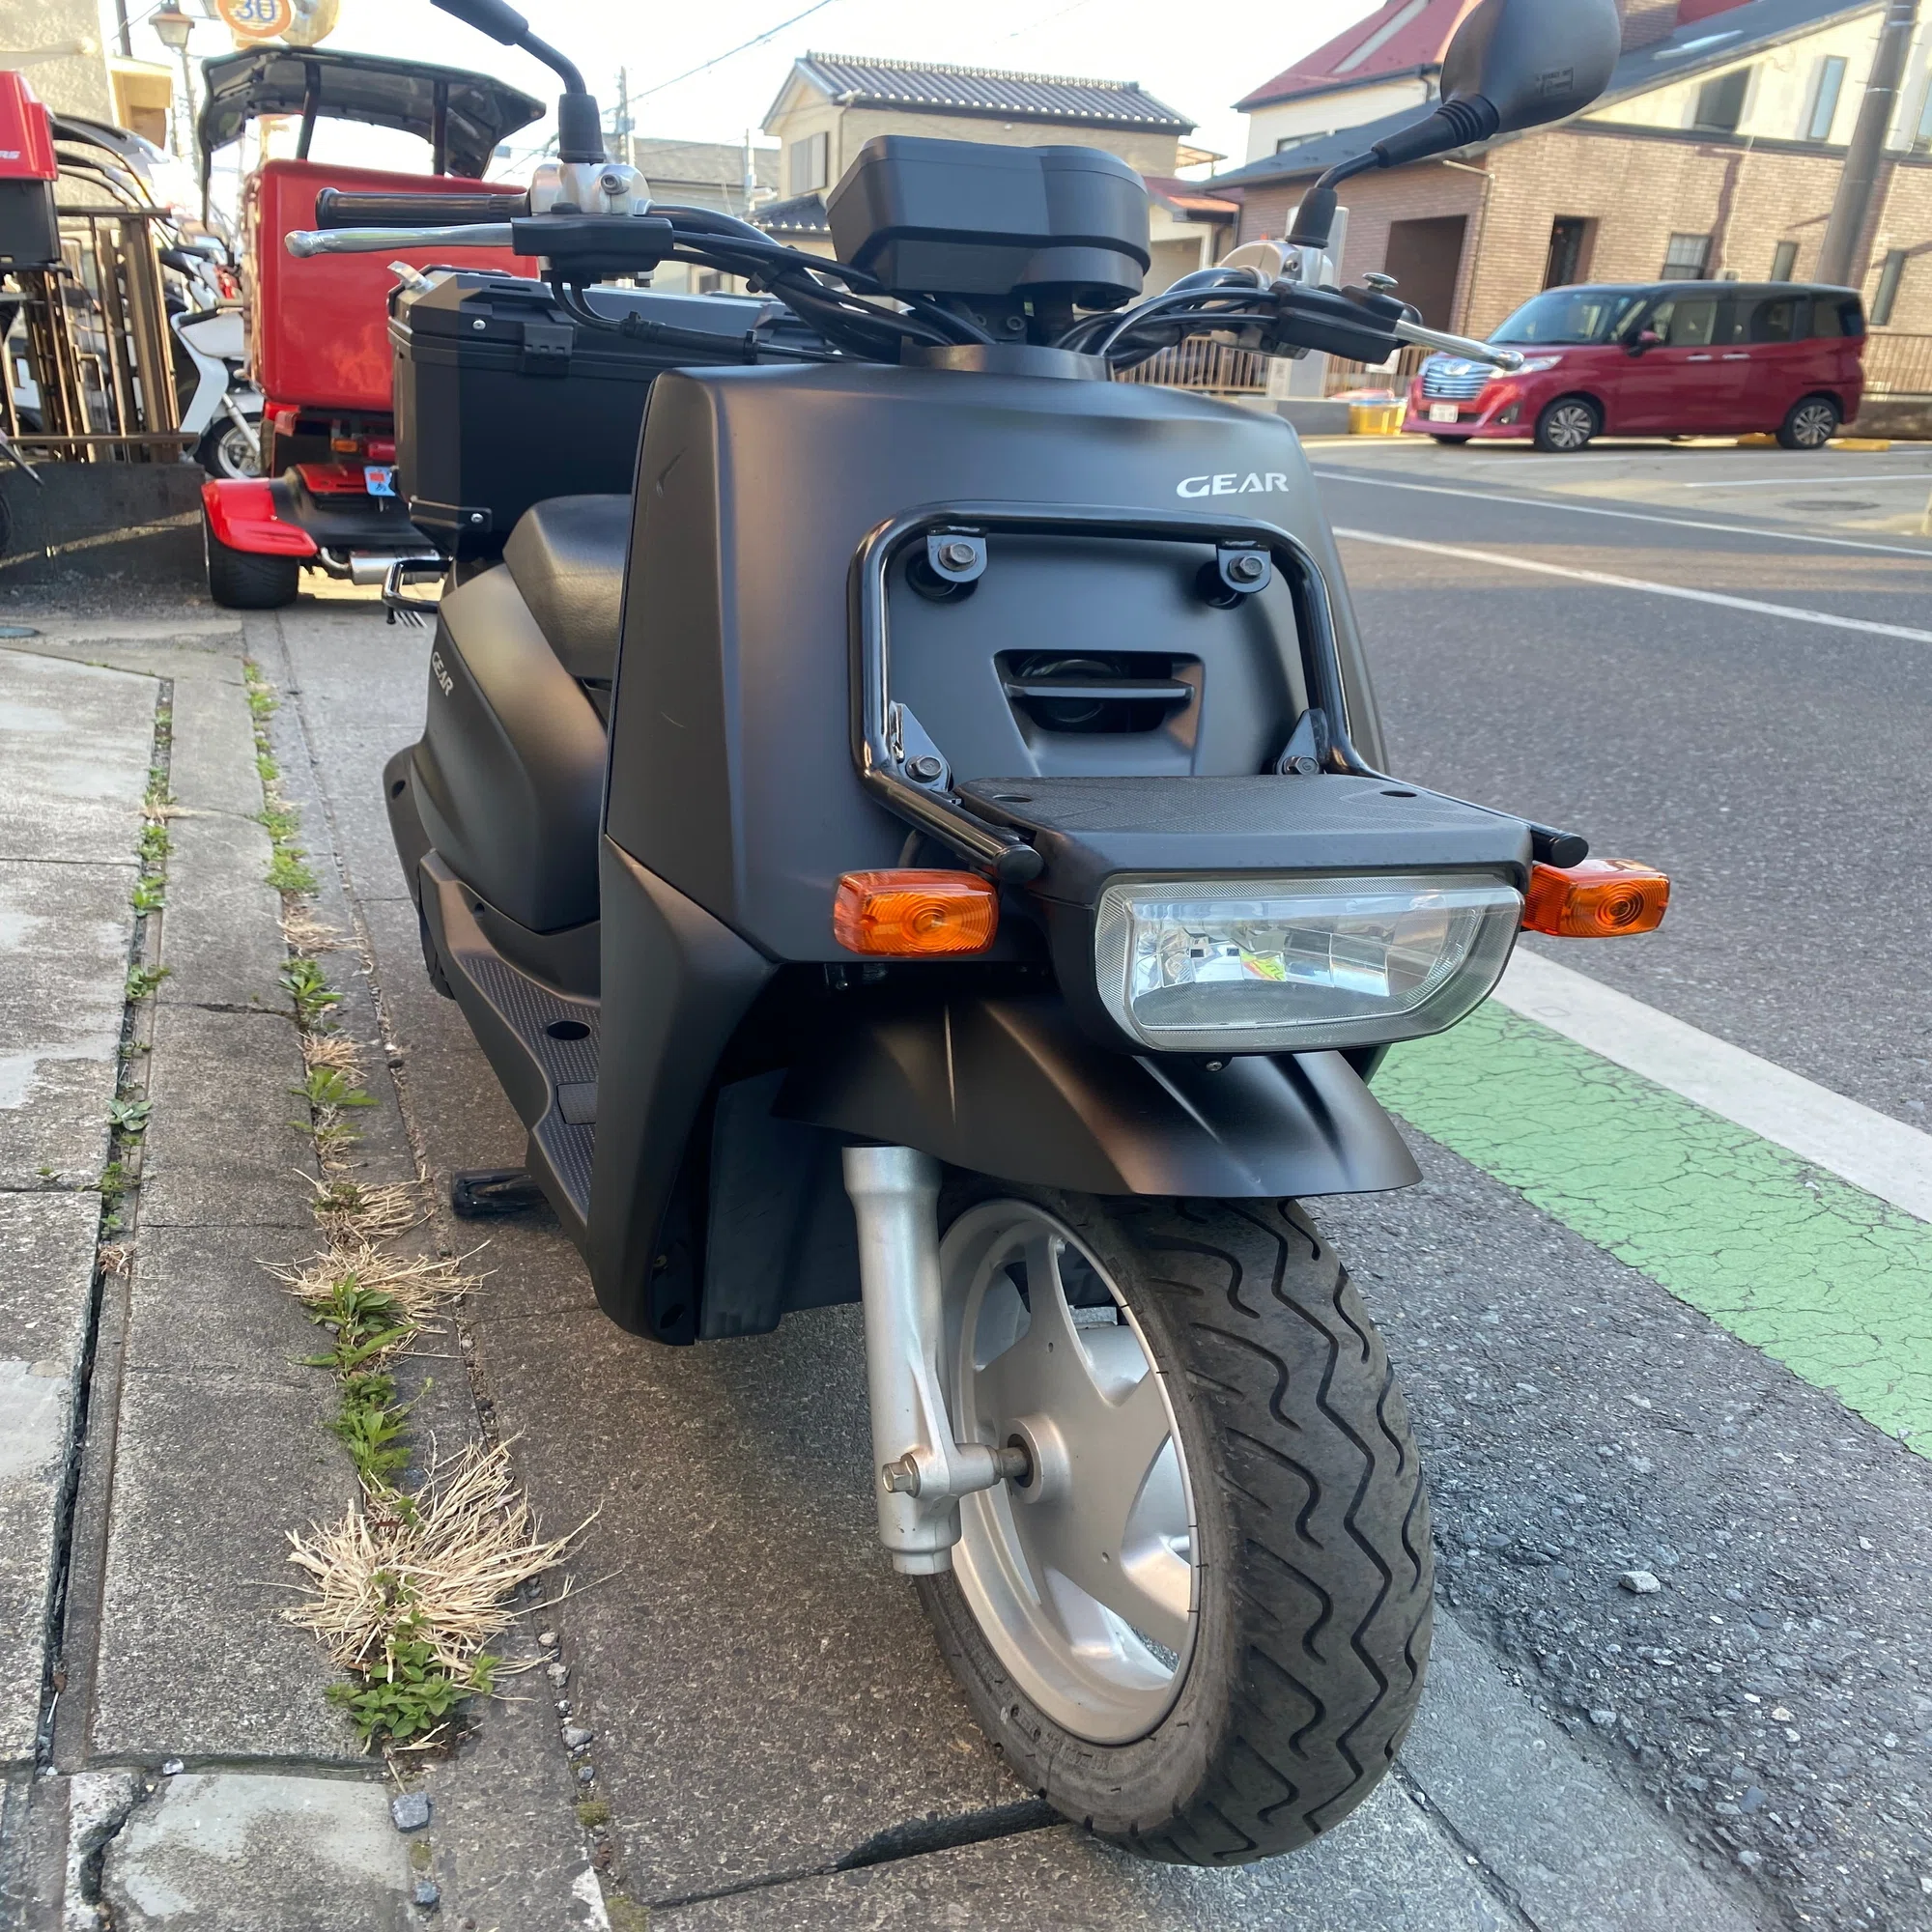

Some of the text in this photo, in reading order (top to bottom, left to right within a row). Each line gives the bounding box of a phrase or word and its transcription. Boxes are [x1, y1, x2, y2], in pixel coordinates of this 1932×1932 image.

[236, 0, 275, 21] 30
[1176, 472, 1290, 498] GEAR
[432, 651, 454, 696] GEAR
